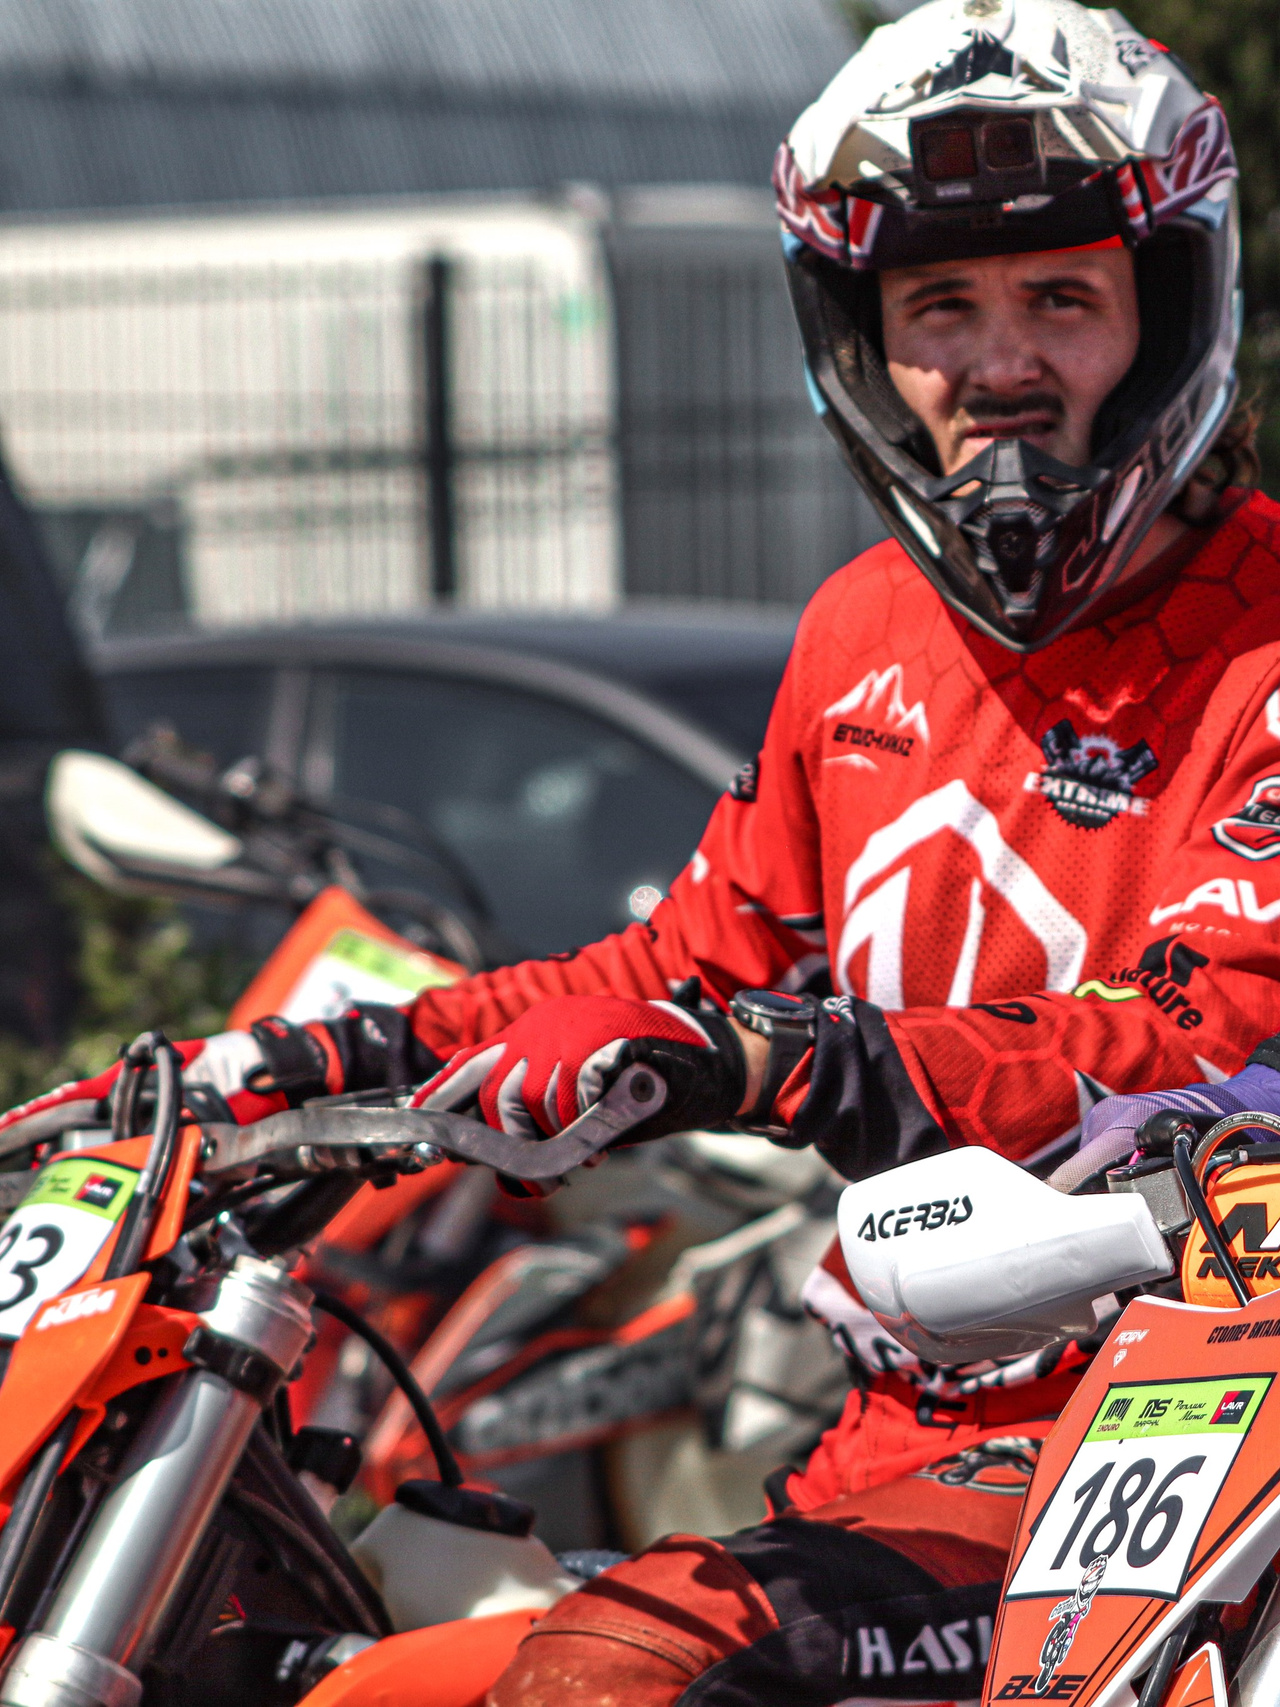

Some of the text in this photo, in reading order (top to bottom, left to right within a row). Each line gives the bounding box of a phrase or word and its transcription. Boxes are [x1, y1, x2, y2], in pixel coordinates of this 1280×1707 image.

[857, 1195, 974, 1242] ACERBIS
[35, 1288, 117, 1331] KTM
[1220, 1401, 1245, 1411] LAVR
[1096, 1423, 1121, 1433] ENDURO
[1049, 1455, 1207, 1570] 186
[993, 1674, 1088, 1701] BSE
